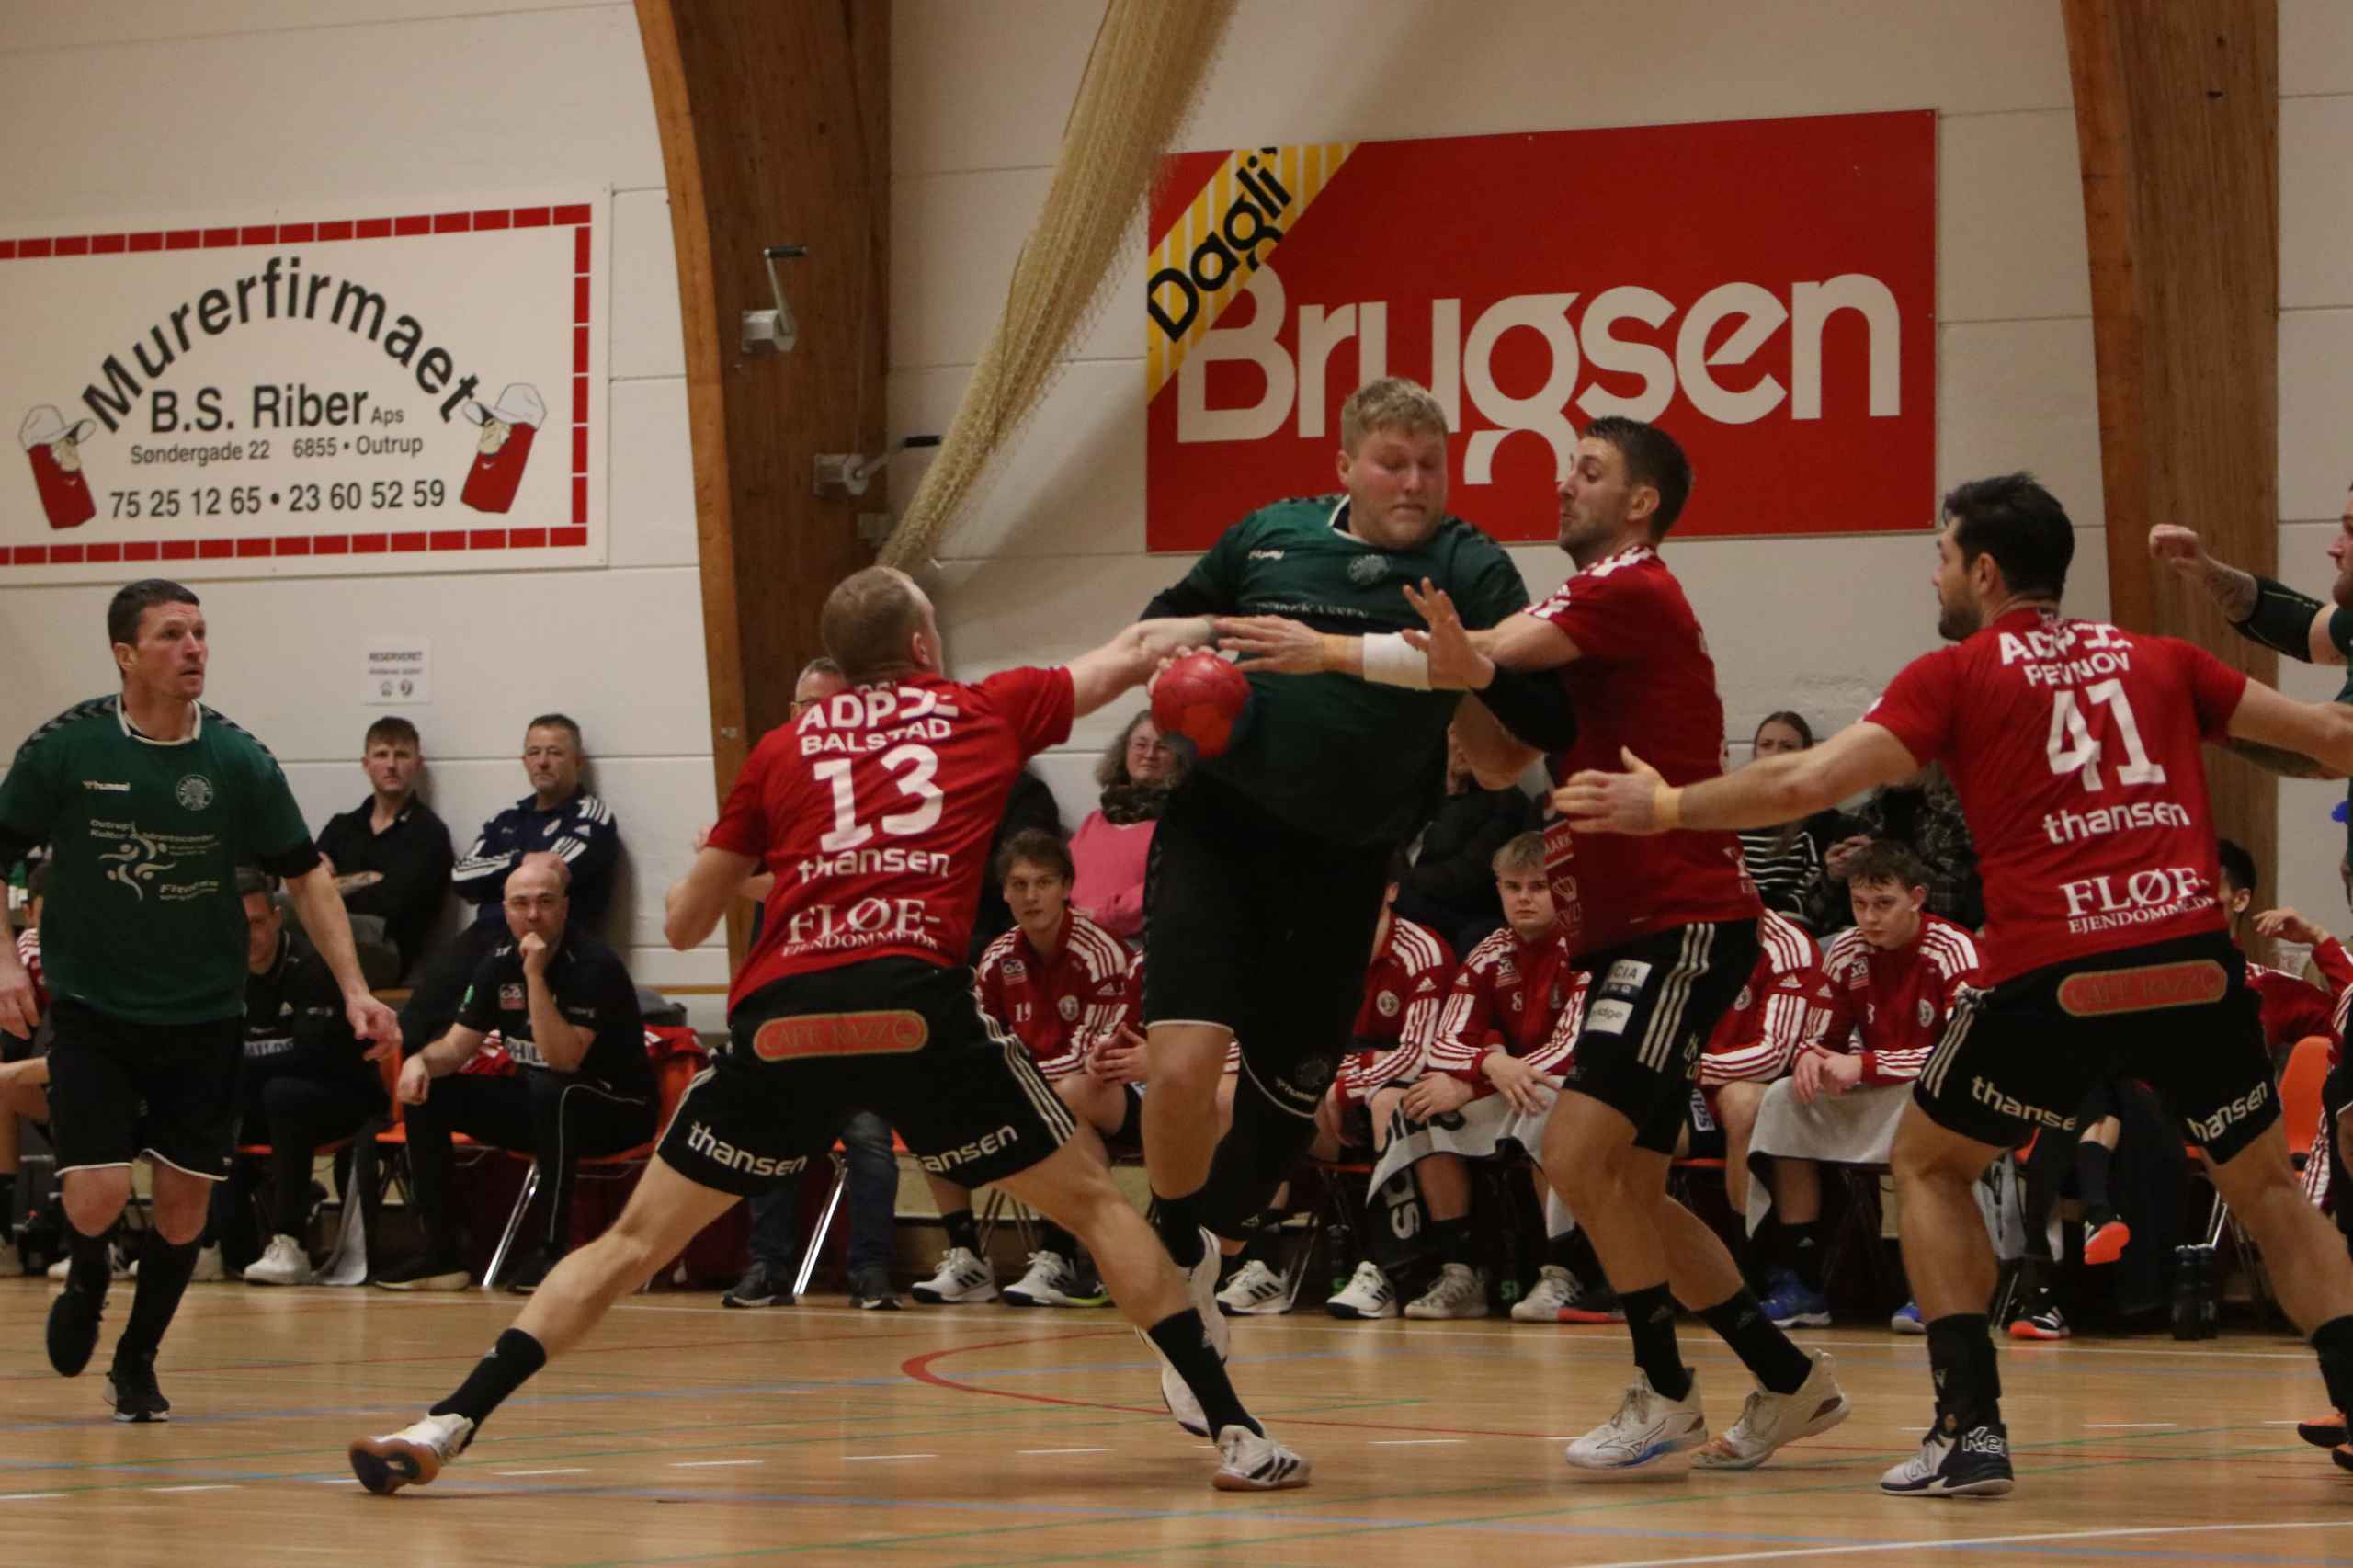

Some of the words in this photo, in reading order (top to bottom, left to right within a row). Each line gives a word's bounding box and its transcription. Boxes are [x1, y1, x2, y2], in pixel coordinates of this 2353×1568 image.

[82, 256, 481, 433] Murerfirmaet
[1176, 261, 1902, 485] Brugsen
[151, 387, 234, 434] B.S.
[253, 383, 369, 429] Riber
[370, 406, 404, 428] Aps
[248, 440, 270, 460] 22
[292, 437, 337, 458] 6855
[356, 434, 423, 458] Outrup
[110, 491, 141, 518] 75
[150, 489, 180, 517] 25
[191, 487, 221, 515] 12
[230, 486, 261, 514] 65
[289, 483, 320, 512] 23
[330, 483, 361, 510] 60
[371, 481, 403, 508] 52
[413, 479, 445, 507] 59
[801, 717, 951, 756] BALSTAD
[2046, 678, 2166, 793] 41
[813, 744, 945, 853] 13
[2042, 801, 2192, 845] thansen
[797, 847, 951, 884] thansen
[1015, 1001, 1032, 1022] 19
[1972, 1075, 2077, 1131] thanse
[2185, 1080, 2268, 1142] hansen
[688, 1120, 808, 1177] thansen
[922, 1124, 1019, 1174] ansen
